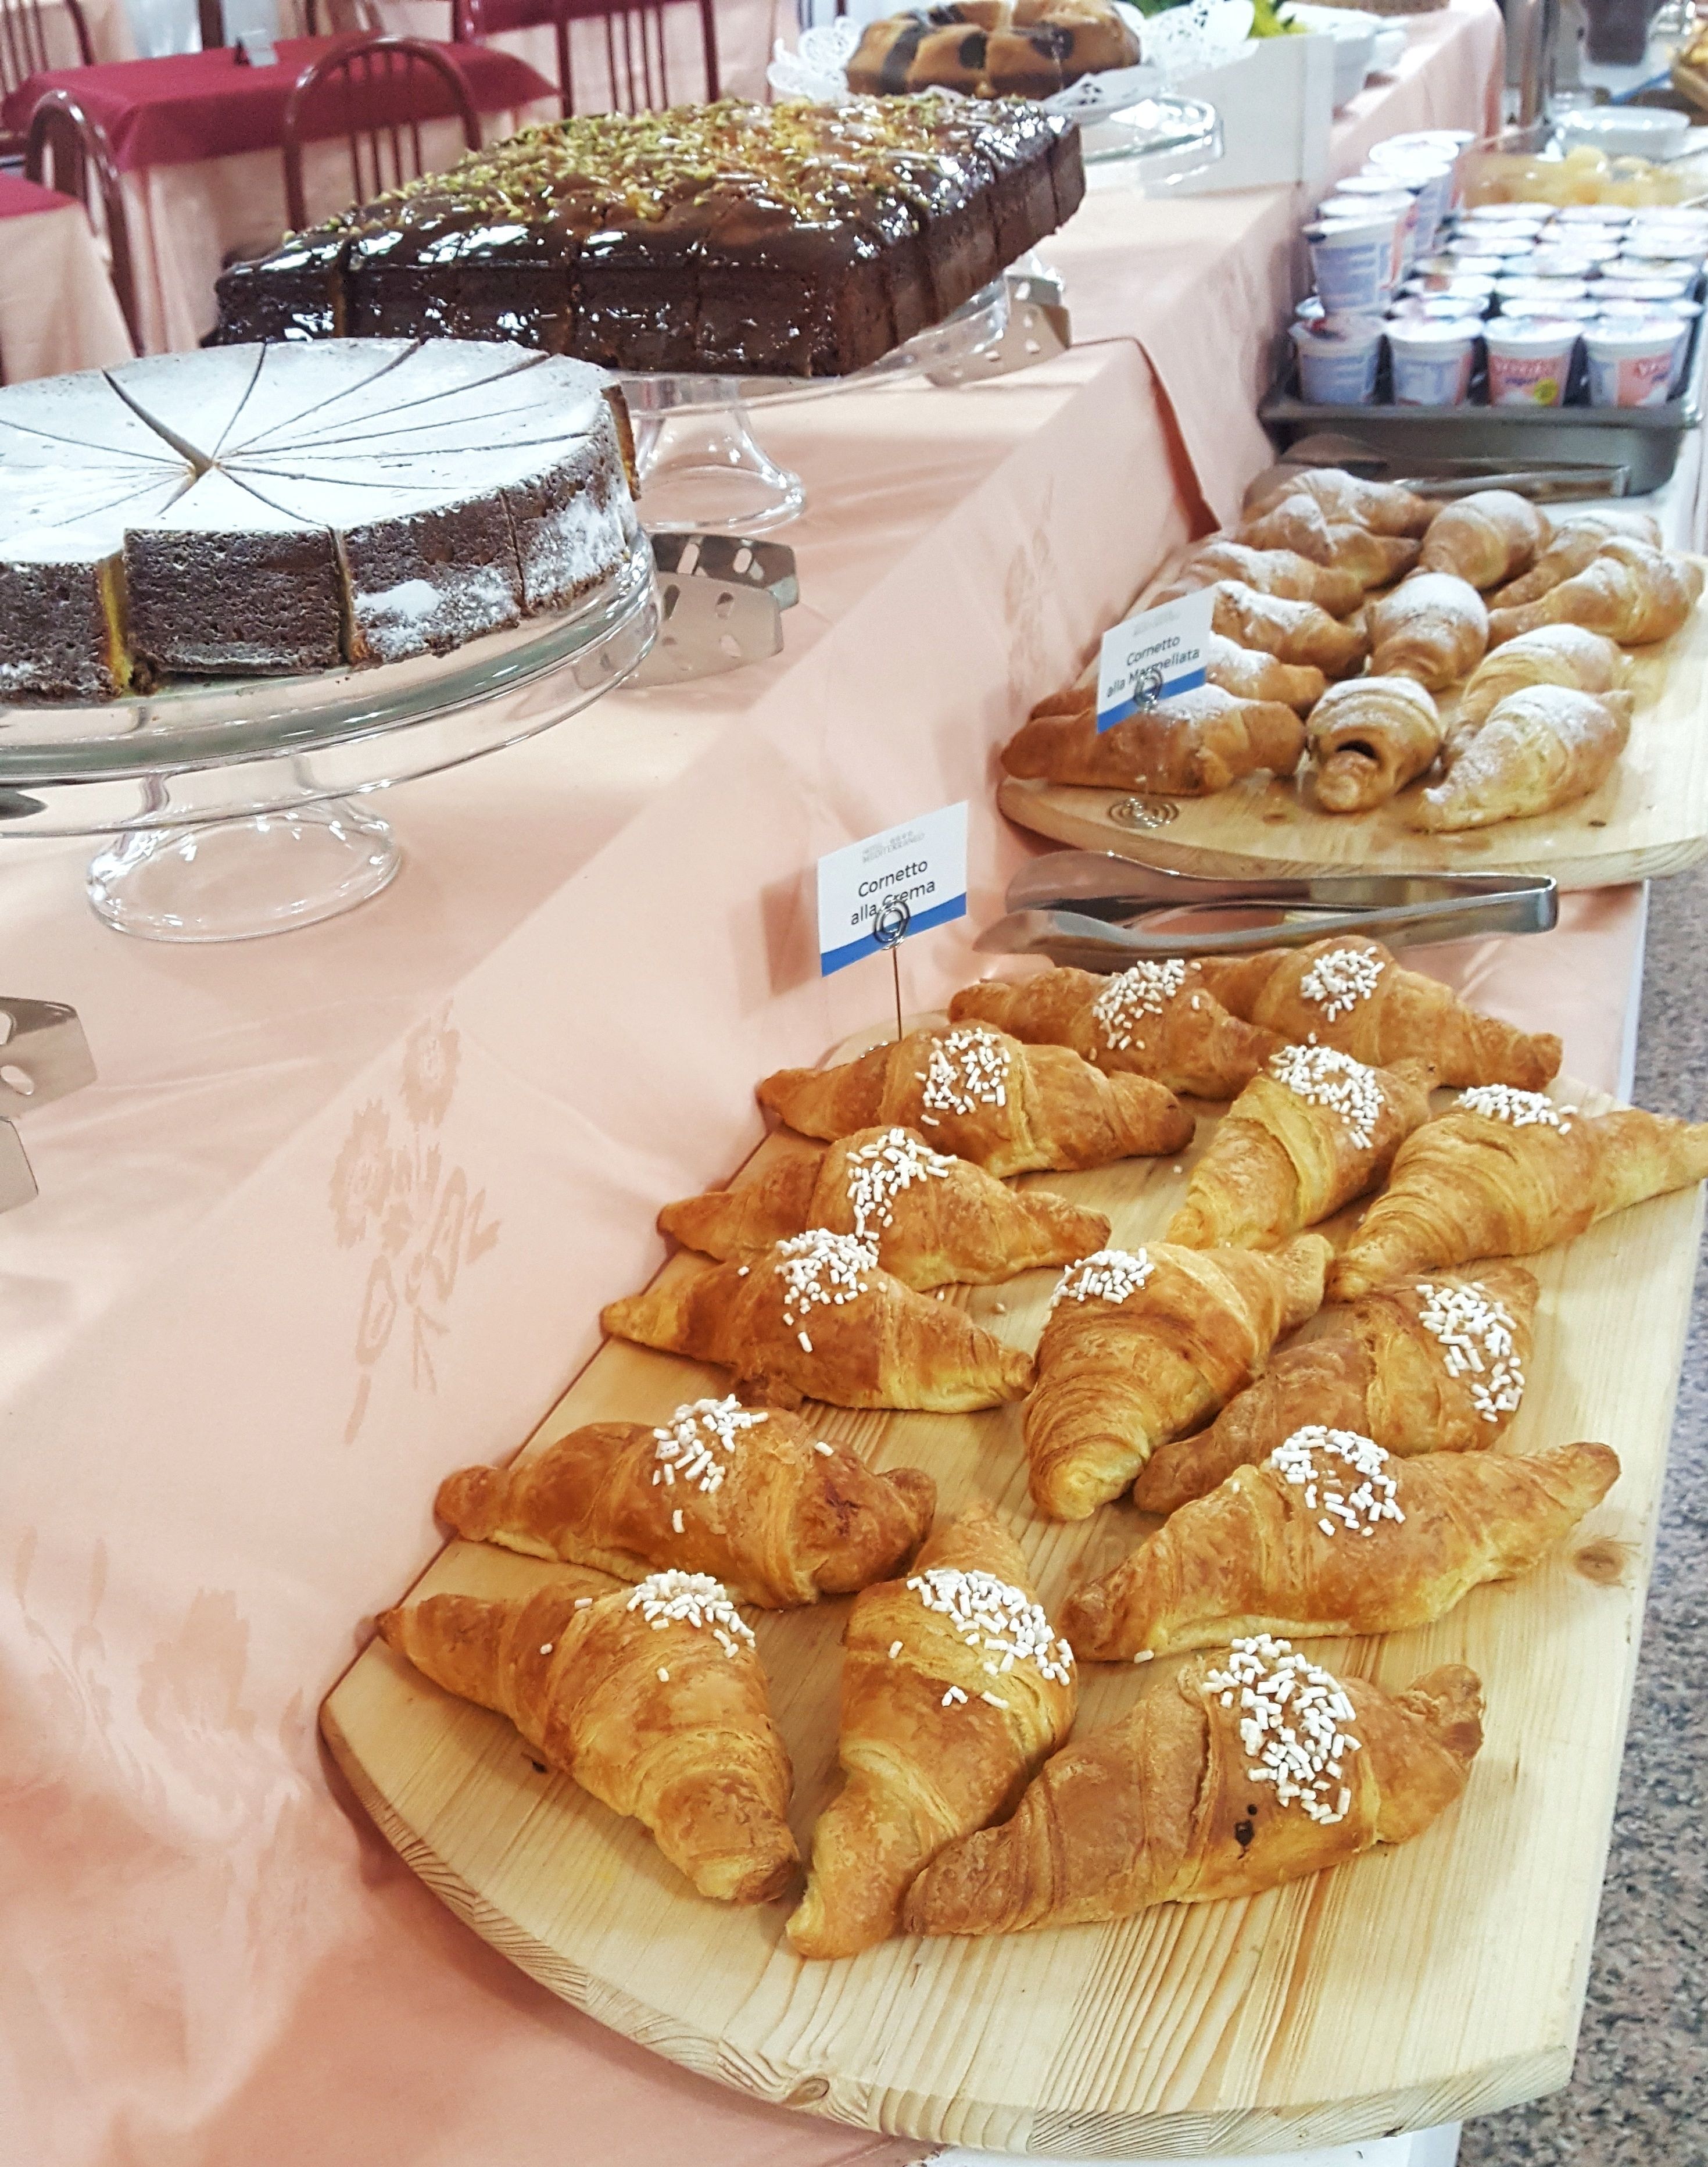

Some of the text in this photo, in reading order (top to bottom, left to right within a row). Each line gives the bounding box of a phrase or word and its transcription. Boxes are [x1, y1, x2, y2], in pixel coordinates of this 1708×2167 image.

[1127, 636, 1180, 666] Cornetto
[1108, 677, 1125, 697] alla
[858, 860, 928, 897] Cornetto
[851, 881, 936, 925] alla Crema
